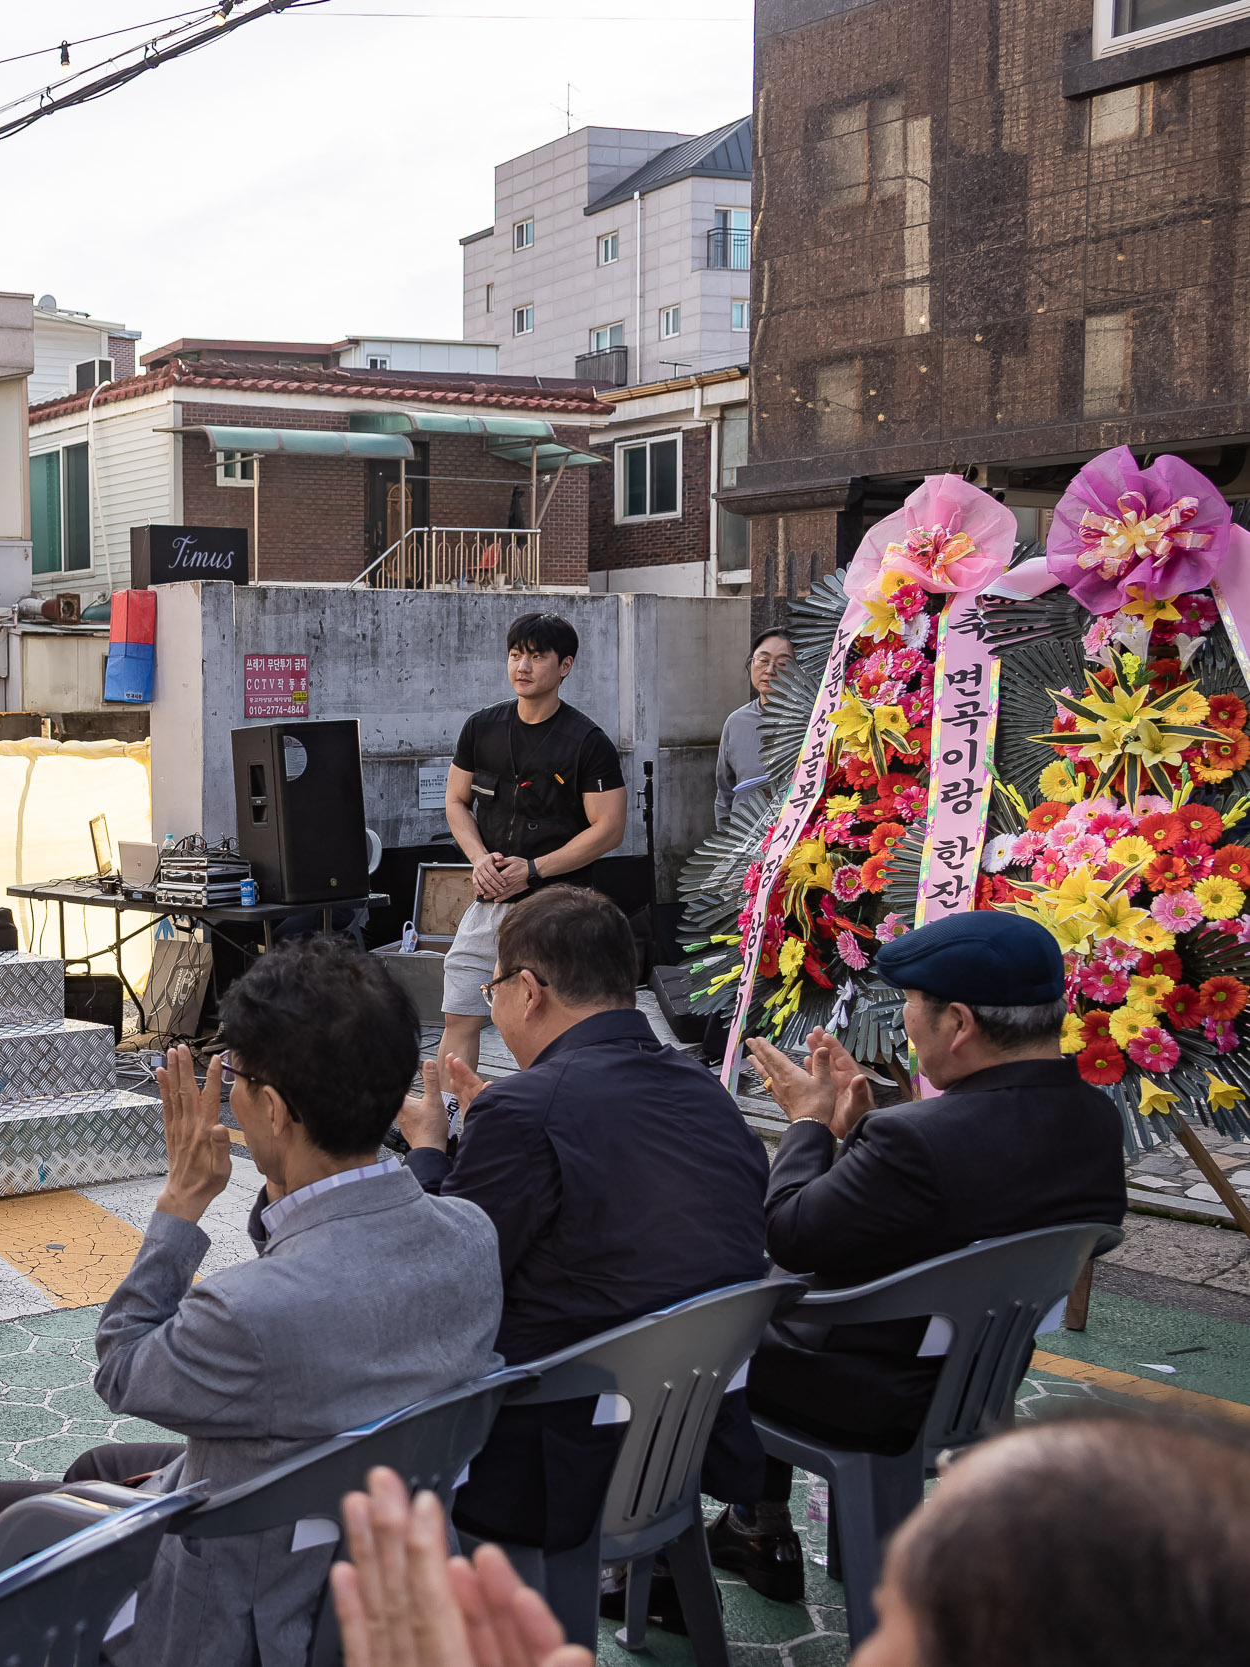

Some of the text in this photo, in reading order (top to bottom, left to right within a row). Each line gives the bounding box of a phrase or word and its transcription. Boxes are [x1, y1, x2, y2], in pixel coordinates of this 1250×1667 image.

[168, 535, 234, 569] Timus
[246, 658, 307, 671] 쓰레기 무단투기 금지
[249, 705, 304, 715] 010-2774-4844
[941, 663, 989, 815] 면곡이랑
